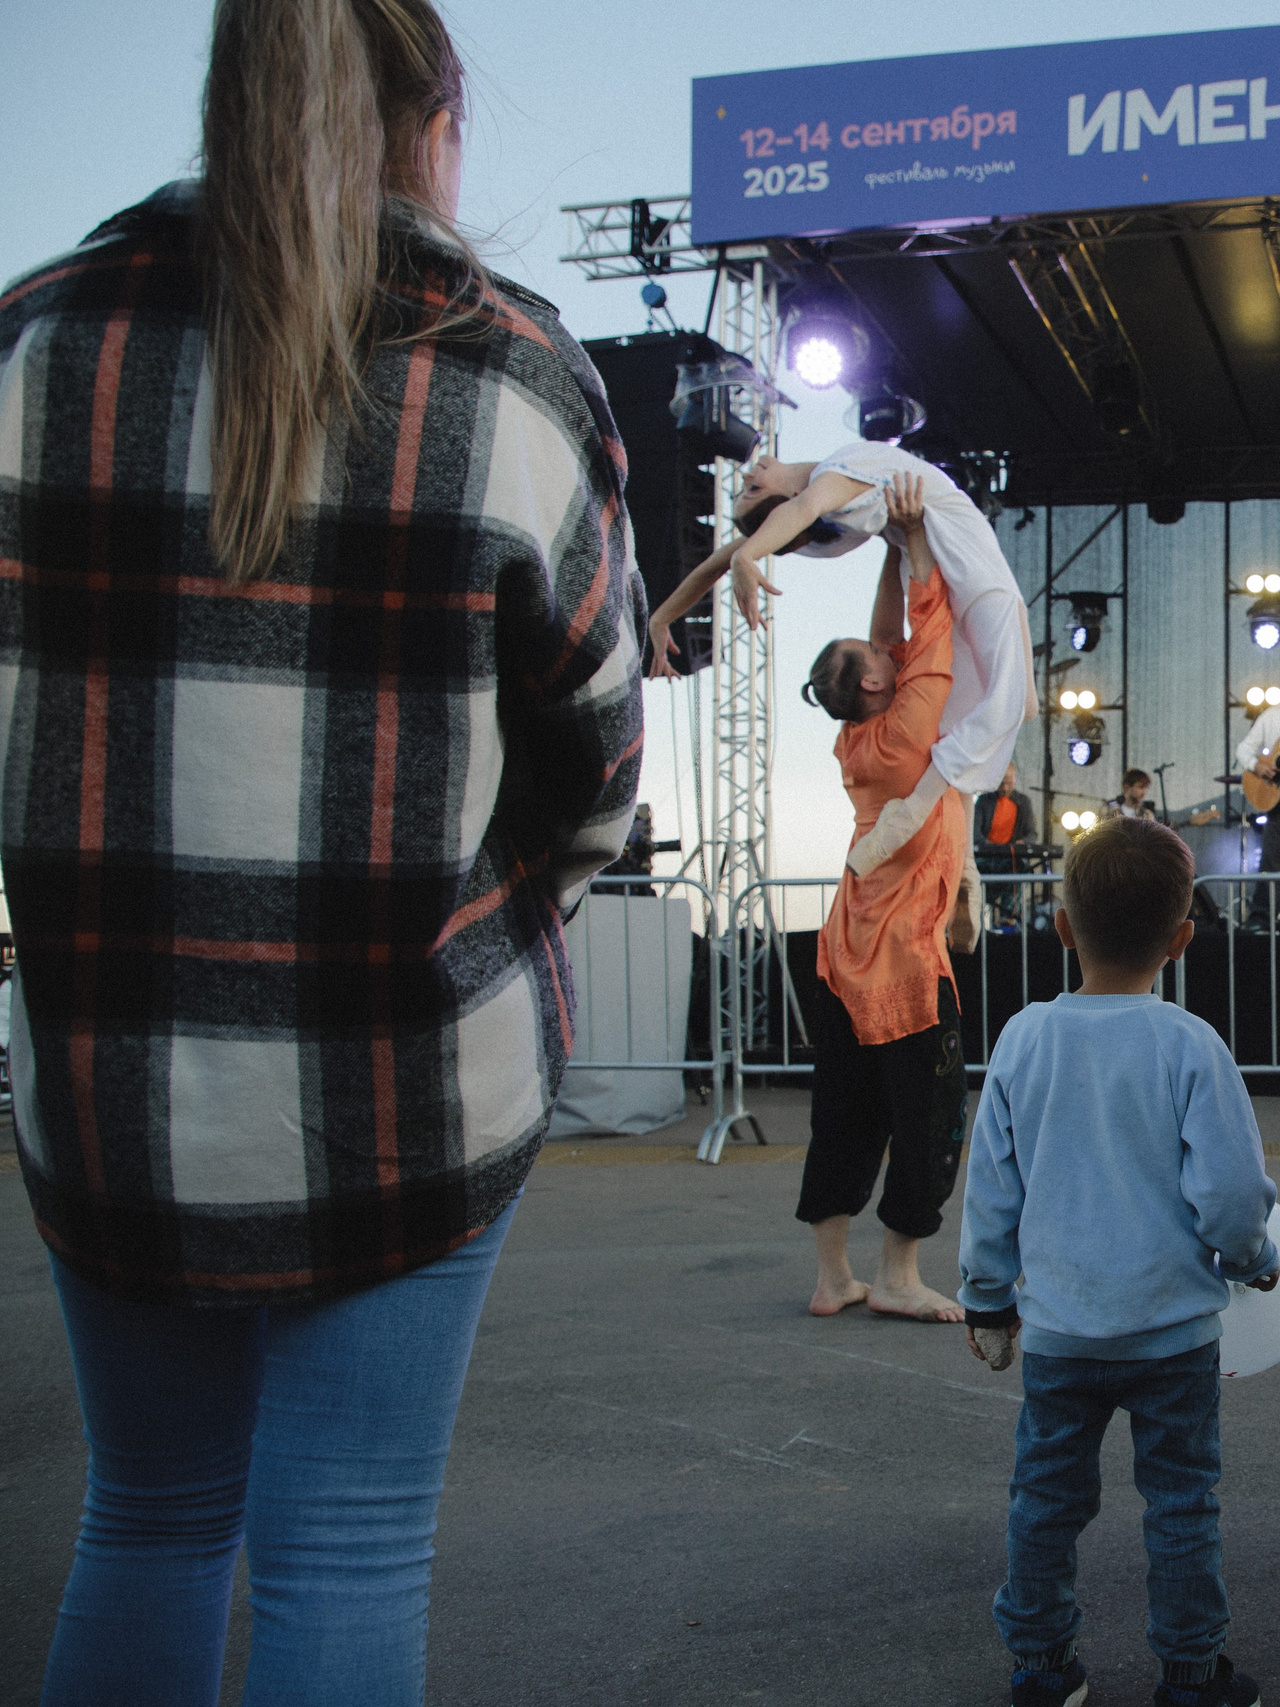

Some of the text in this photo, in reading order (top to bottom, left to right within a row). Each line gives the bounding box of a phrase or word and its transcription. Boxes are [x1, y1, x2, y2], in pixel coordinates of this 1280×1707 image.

[840, 104, 1017, 150] сентября
[743, 160, 829, 198] 2025
[864, 159, 1016, 190] фестиваль музыки
